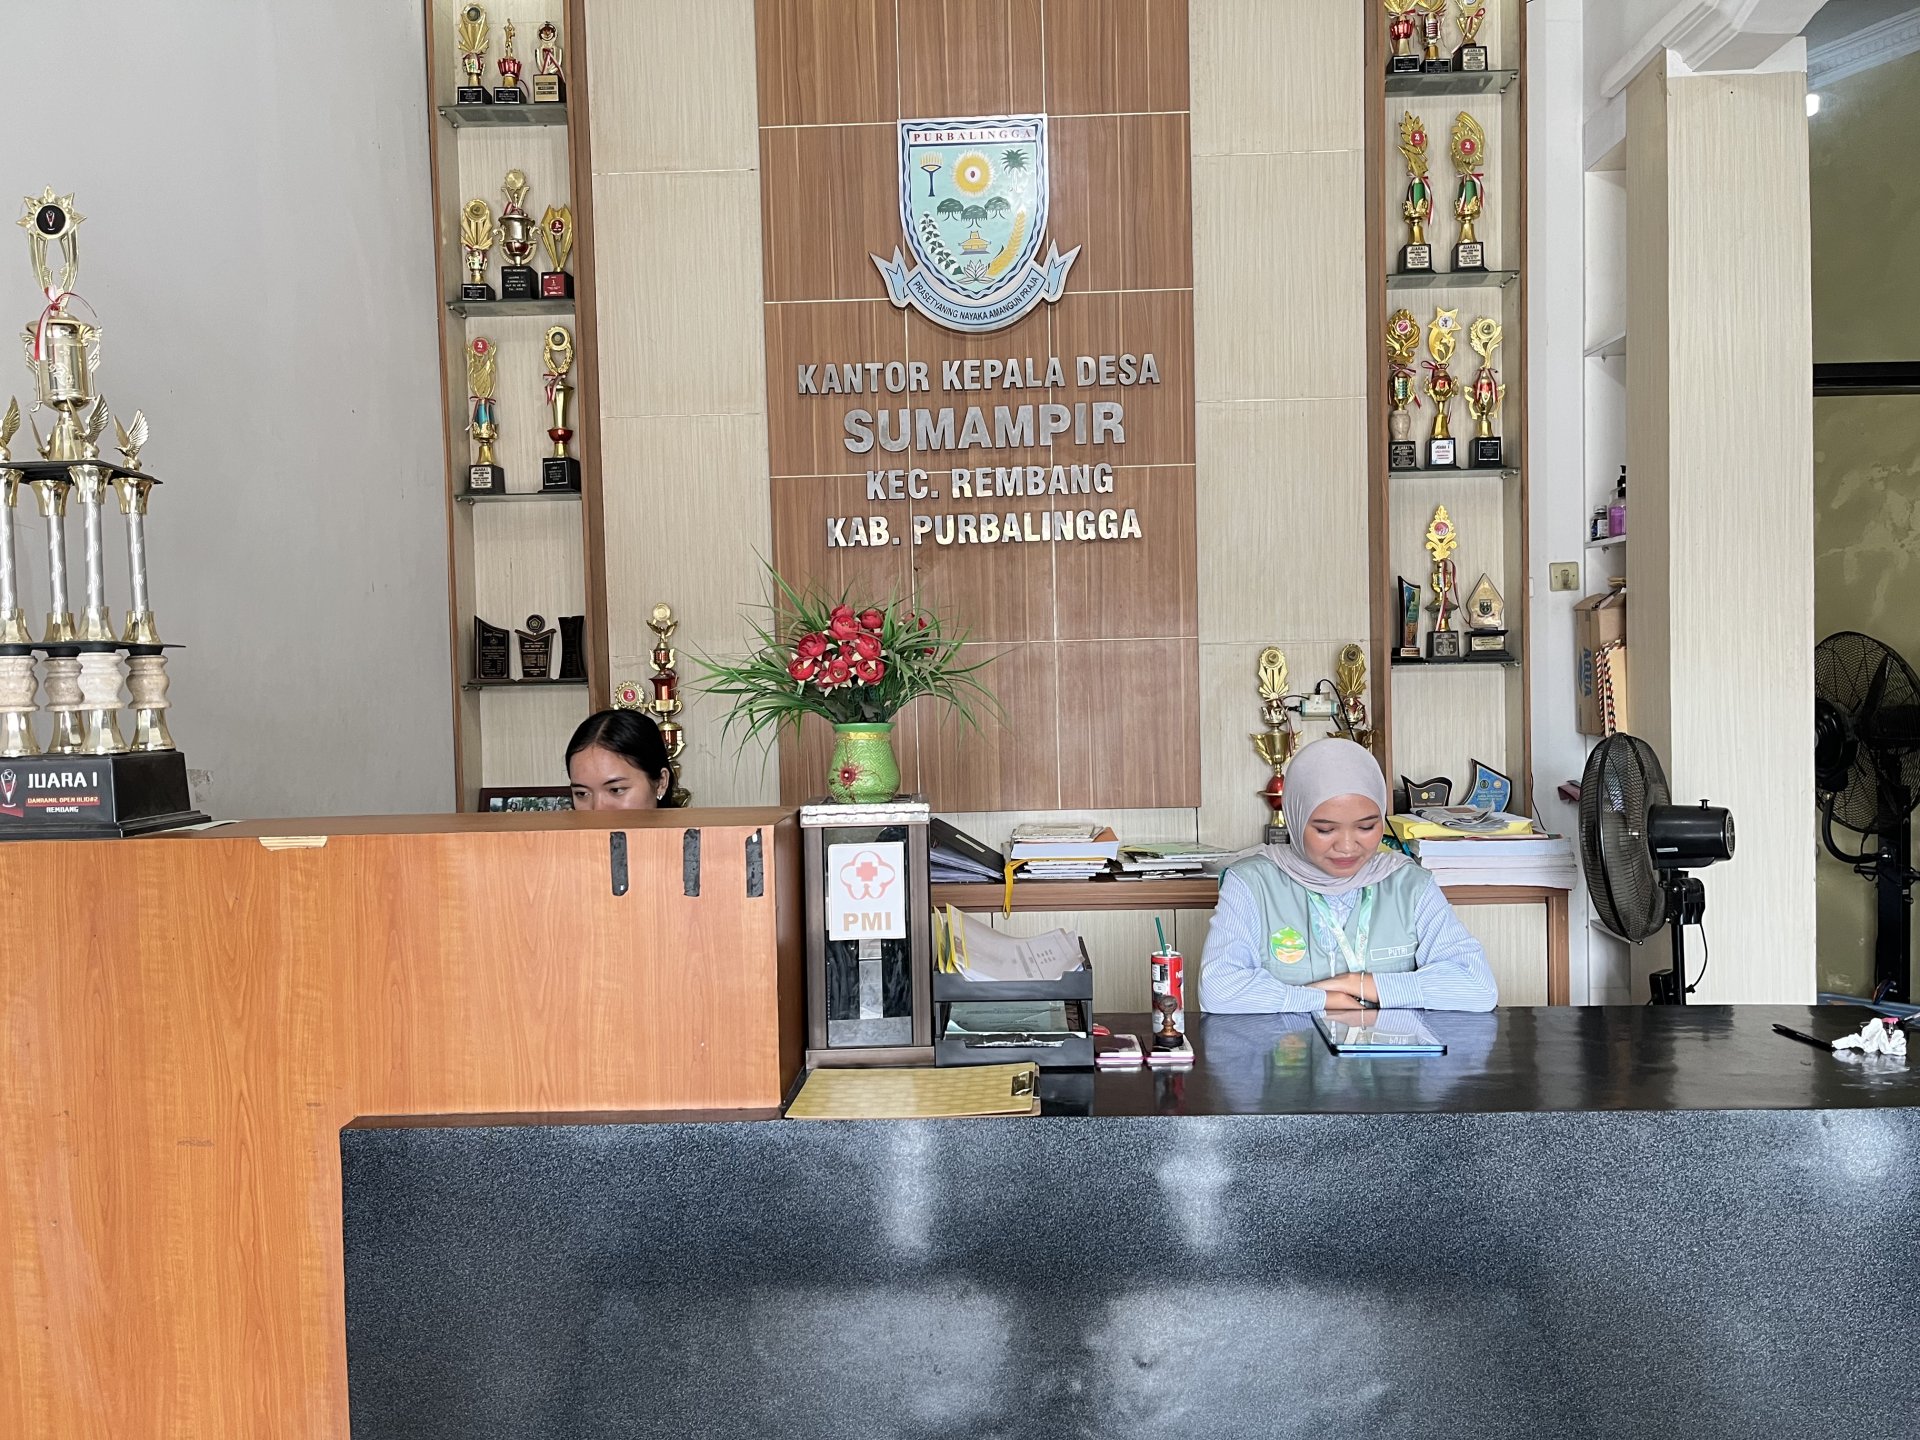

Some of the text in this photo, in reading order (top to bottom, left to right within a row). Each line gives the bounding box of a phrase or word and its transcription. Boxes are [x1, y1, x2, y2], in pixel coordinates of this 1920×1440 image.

[913, 128, 1034, 142] PURBALINGGA
[912, 276, 1040, 321] PRASETYANING NAYAKA AMANGUN PRAJA
[797, 353, 1161, 395] KANTOR KEPALA DESA
[843, 401, 1126, 454] SUMAMPIR
[866, 462, 1114, 501] KEC. REMBANG
[826, 508, 1143, 548] KAB. PURBALINGGA
[28, 771, 98, 788] JUARA I
[843, 911, 892, 932] PMI
[1388, 947, 1408, 957] PUTRI
